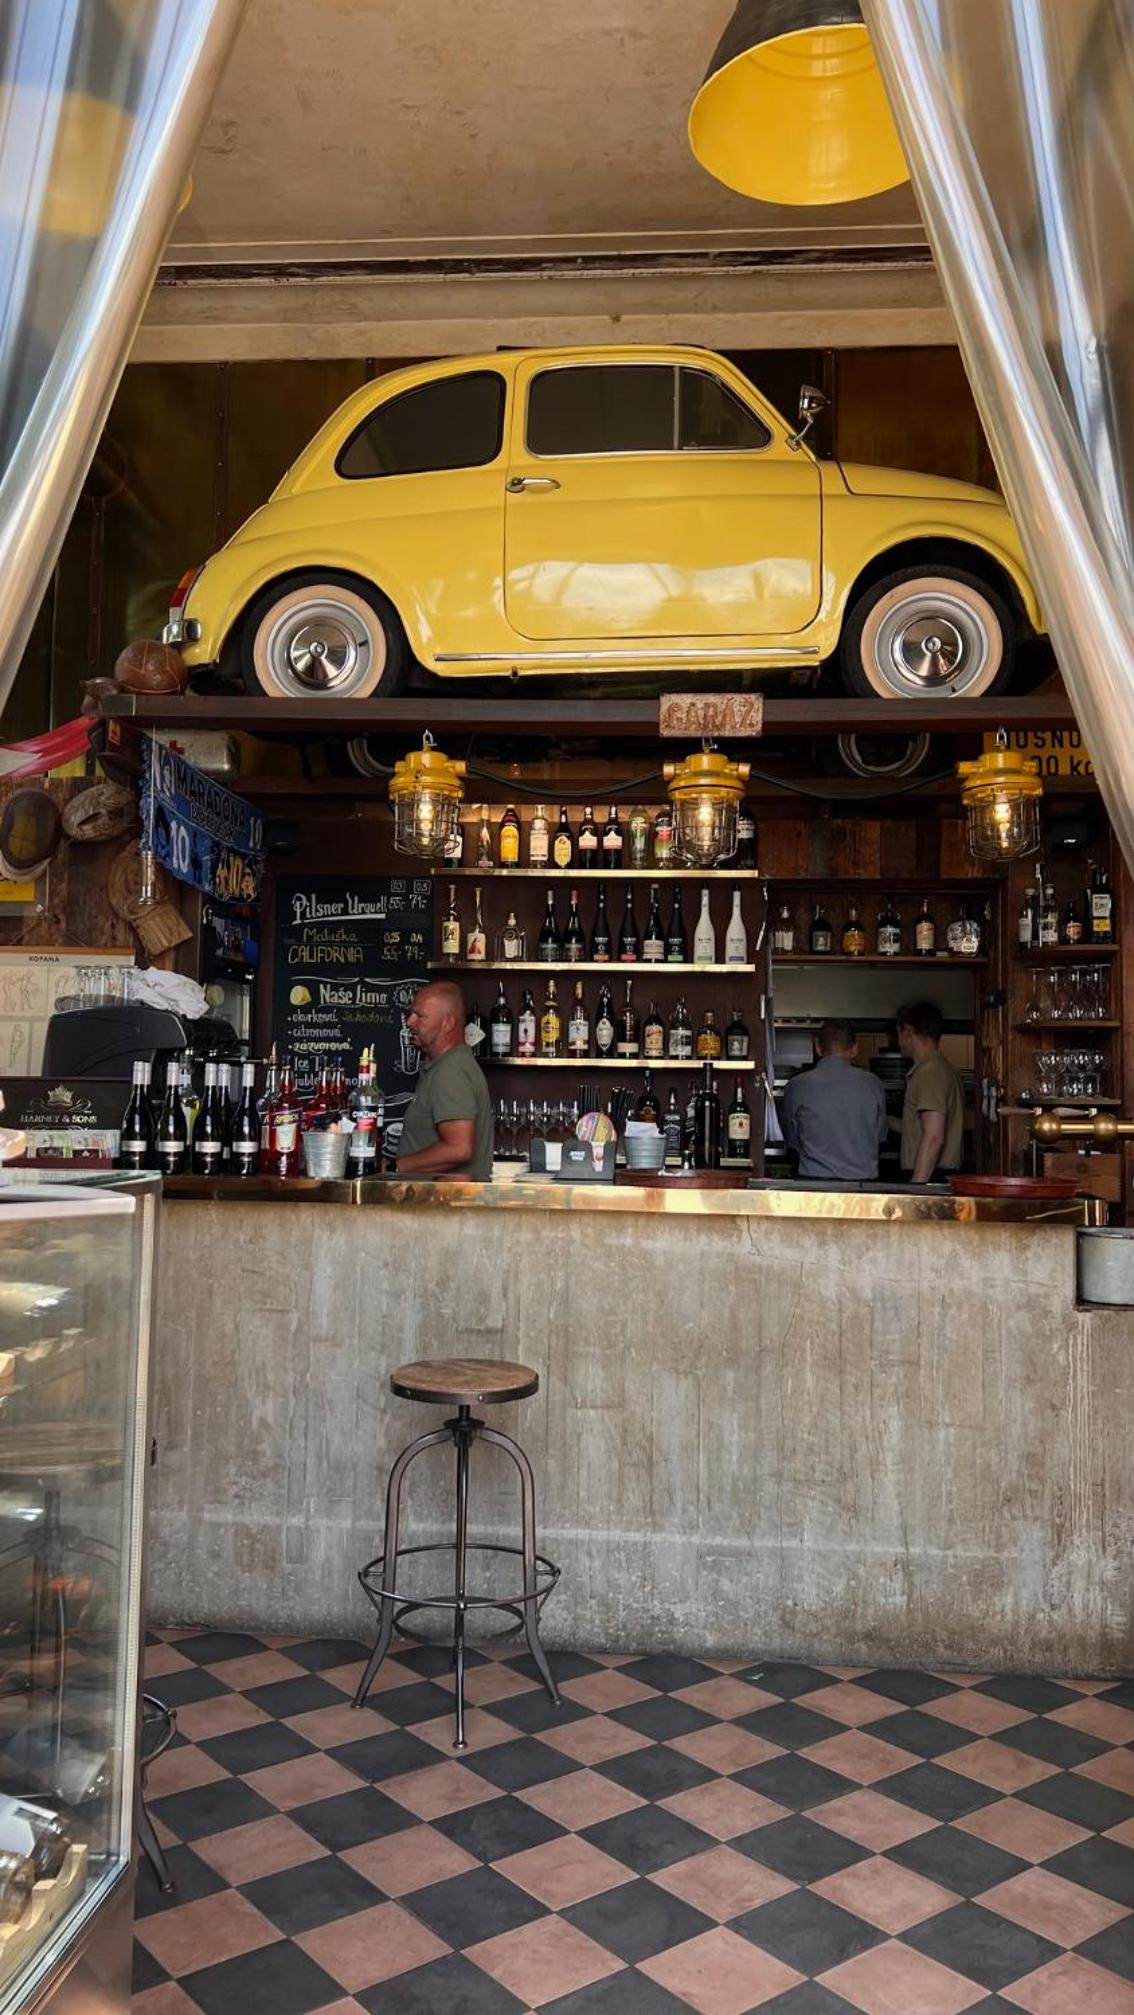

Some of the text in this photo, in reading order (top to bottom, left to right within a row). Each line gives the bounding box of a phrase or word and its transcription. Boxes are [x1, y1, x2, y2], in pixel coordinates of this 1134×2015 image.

[170, 819, 190, 874] 10
[292, 893, 344, 922] Pilsner
[346, 891, 388, 915] Urquell
[288, 945, 364, 965] CALIFORNIA
[319, 983, 388, 1005] Naše Limo
[294, 1056, 310, 1072] Ice
[72, 1114, 98, 1123] SONS
